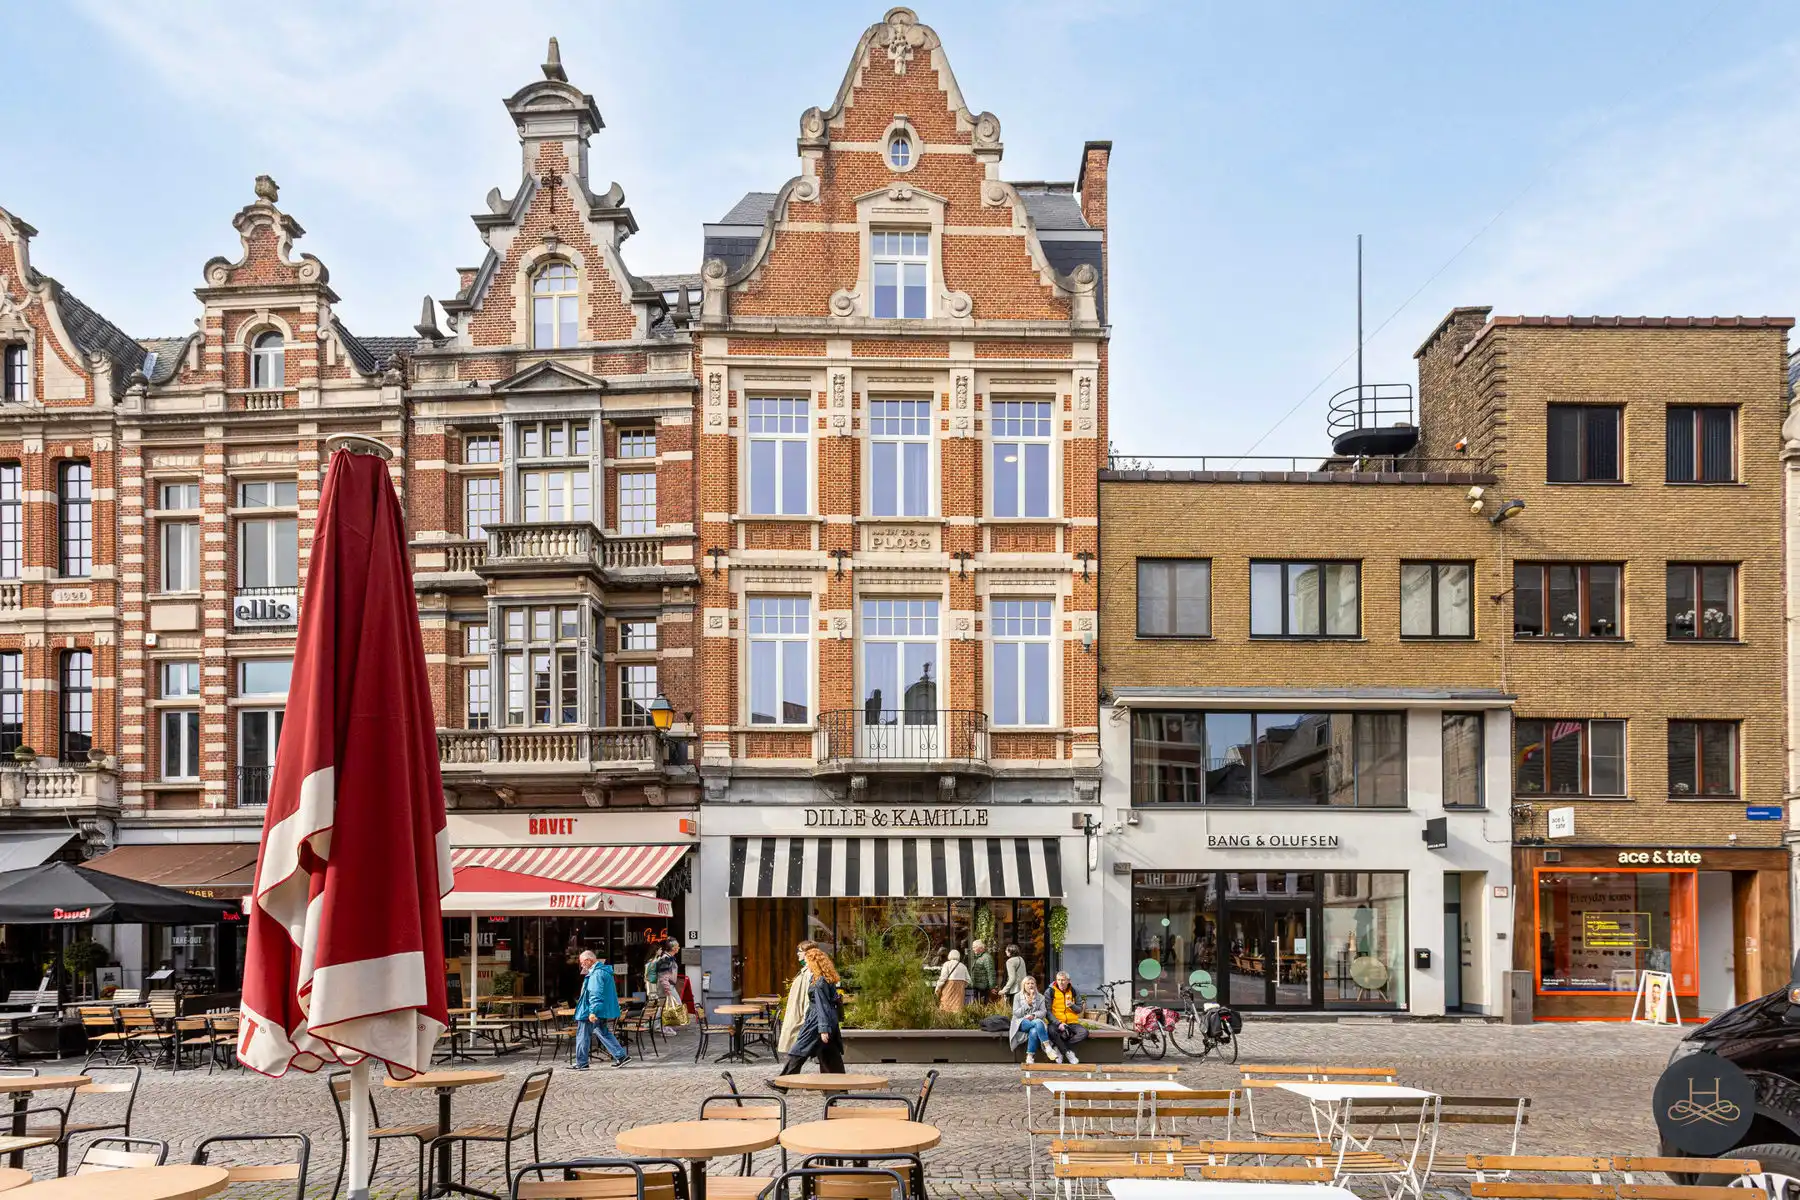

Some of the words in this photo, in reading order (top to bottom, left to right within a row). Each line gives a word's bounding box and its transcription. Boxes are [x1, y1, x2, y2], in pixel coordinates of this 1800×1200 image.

[235, 599, 291, 620] ellis
[804, 809, 866, 827] DILLE
[871, 809, 888, 827] &
[892, 809, 989, 827] KAMILLE
[1207, 835, 1250, 847] BANG
[1256, 835, 1266, 847] &
[1269, 835, 1339, 847] OLUFSEN
[1618, 851, 1650, 864] ace
[1652, 850, 1666, 864] &
[1666, 850, 1702, 864] tate
[549, 894, 588, 908] BAVET
[53, 907, 91, 920] Duvel
[172, 936, 202, 945] TAKE-OUT
[463, 932, 494, 946] BVET
[690, 931, 697, 939] 8
